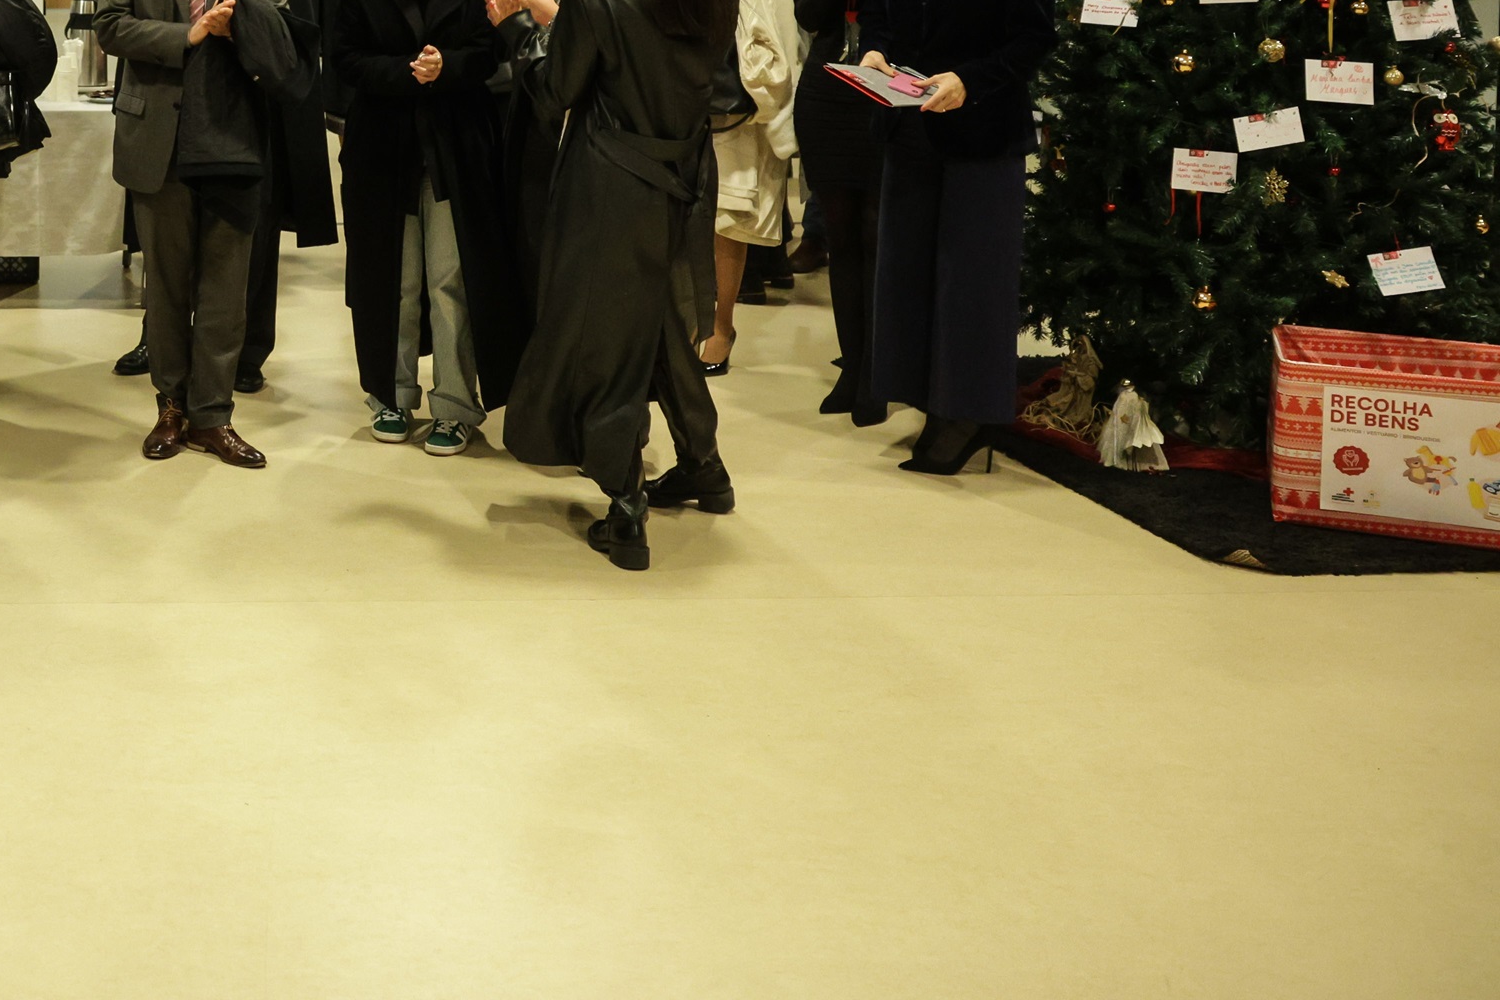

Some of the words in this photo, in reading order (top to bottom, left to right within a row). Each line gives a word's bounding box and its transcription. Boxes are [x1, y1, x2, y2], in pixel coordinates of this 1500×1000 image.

[1331, 394, 1433, 417] RECOLHA
[1330, 409, 1357, 425] DE
[1364, 412, 1420, 432] BENS
